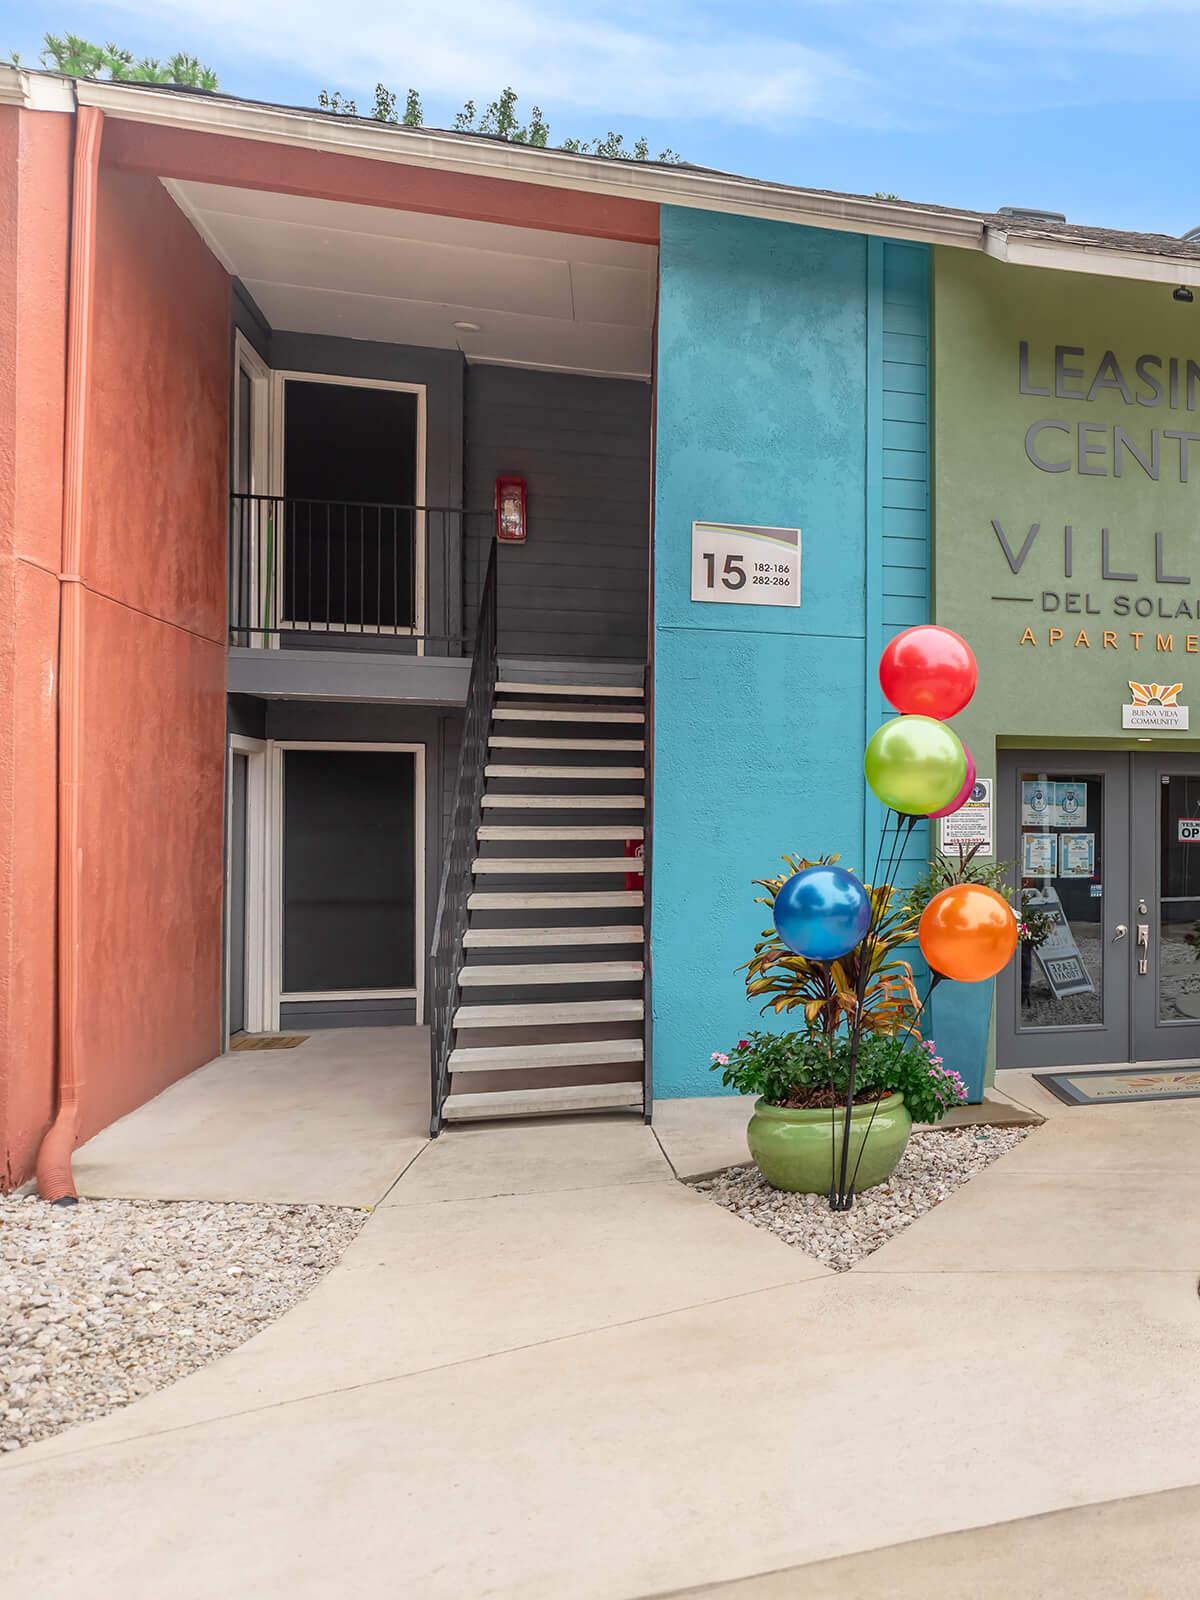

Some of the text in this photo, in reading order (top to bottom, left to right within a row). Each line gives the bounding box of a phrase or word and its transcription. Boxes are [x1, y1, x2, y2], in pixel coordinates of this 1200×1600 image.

[703, 553, 747, 590] 15
[754, 562, 790, 574] 182-186
[752, 575, 790, 587] 282-286
[1041, 591, 1101, 615] DEL
[1132, 709, 1157, 717] BUENA
